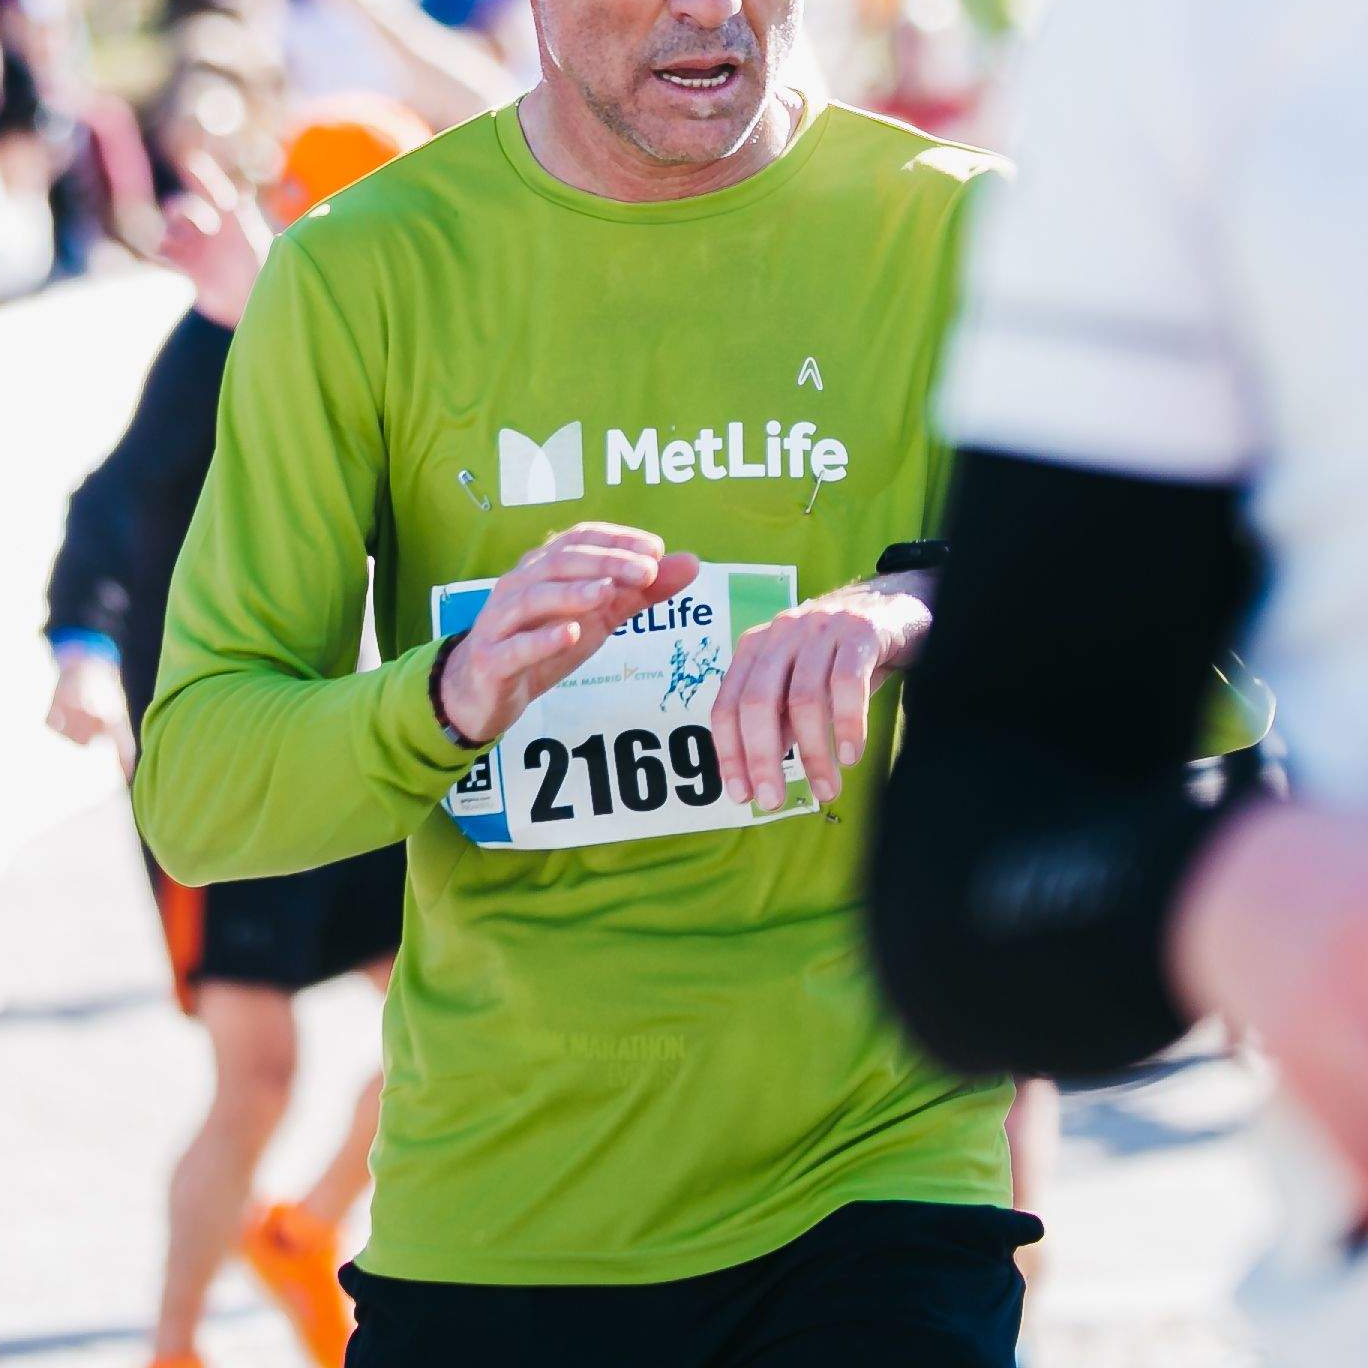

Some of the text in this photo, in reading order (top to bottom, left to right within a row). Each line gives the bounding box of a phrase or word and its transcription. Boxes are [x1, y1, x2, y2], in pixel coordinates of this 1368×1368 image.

[606, 420, 849, 486] MetLife
[611, 596, 713, 637] tLife
[523, 724, 723, 823] 2169
